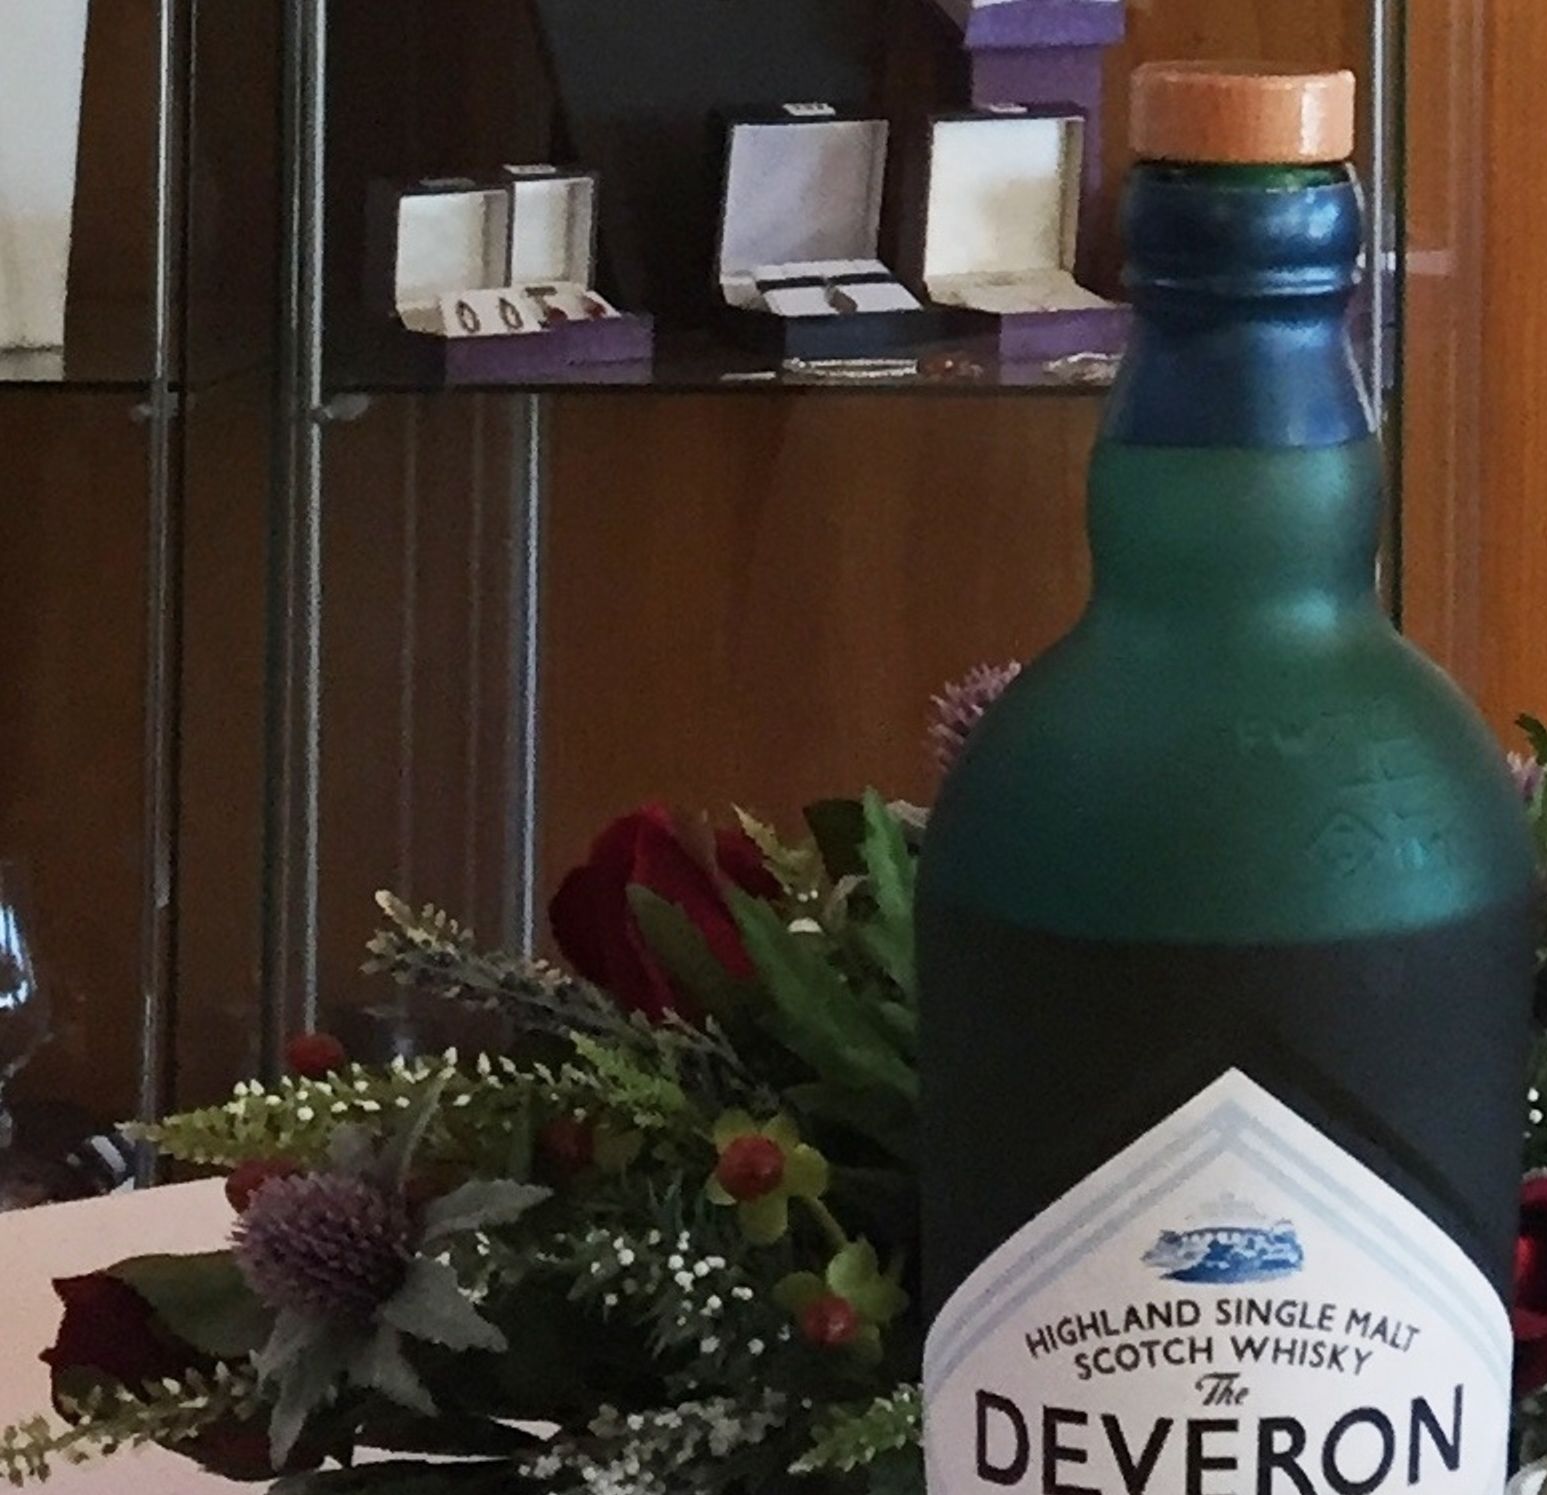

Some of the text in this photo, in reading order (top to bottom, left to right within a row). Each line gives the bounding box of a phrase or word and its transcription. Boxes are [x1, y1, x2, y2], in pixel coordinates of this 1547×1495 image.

[1025, 1297, 1421, 1359] HIGHLAND SINGLE MALT
[1074, 1335, 1373, 1381] SCOTCH WHISKY
[1195, 1372, 1250, 1407] The
